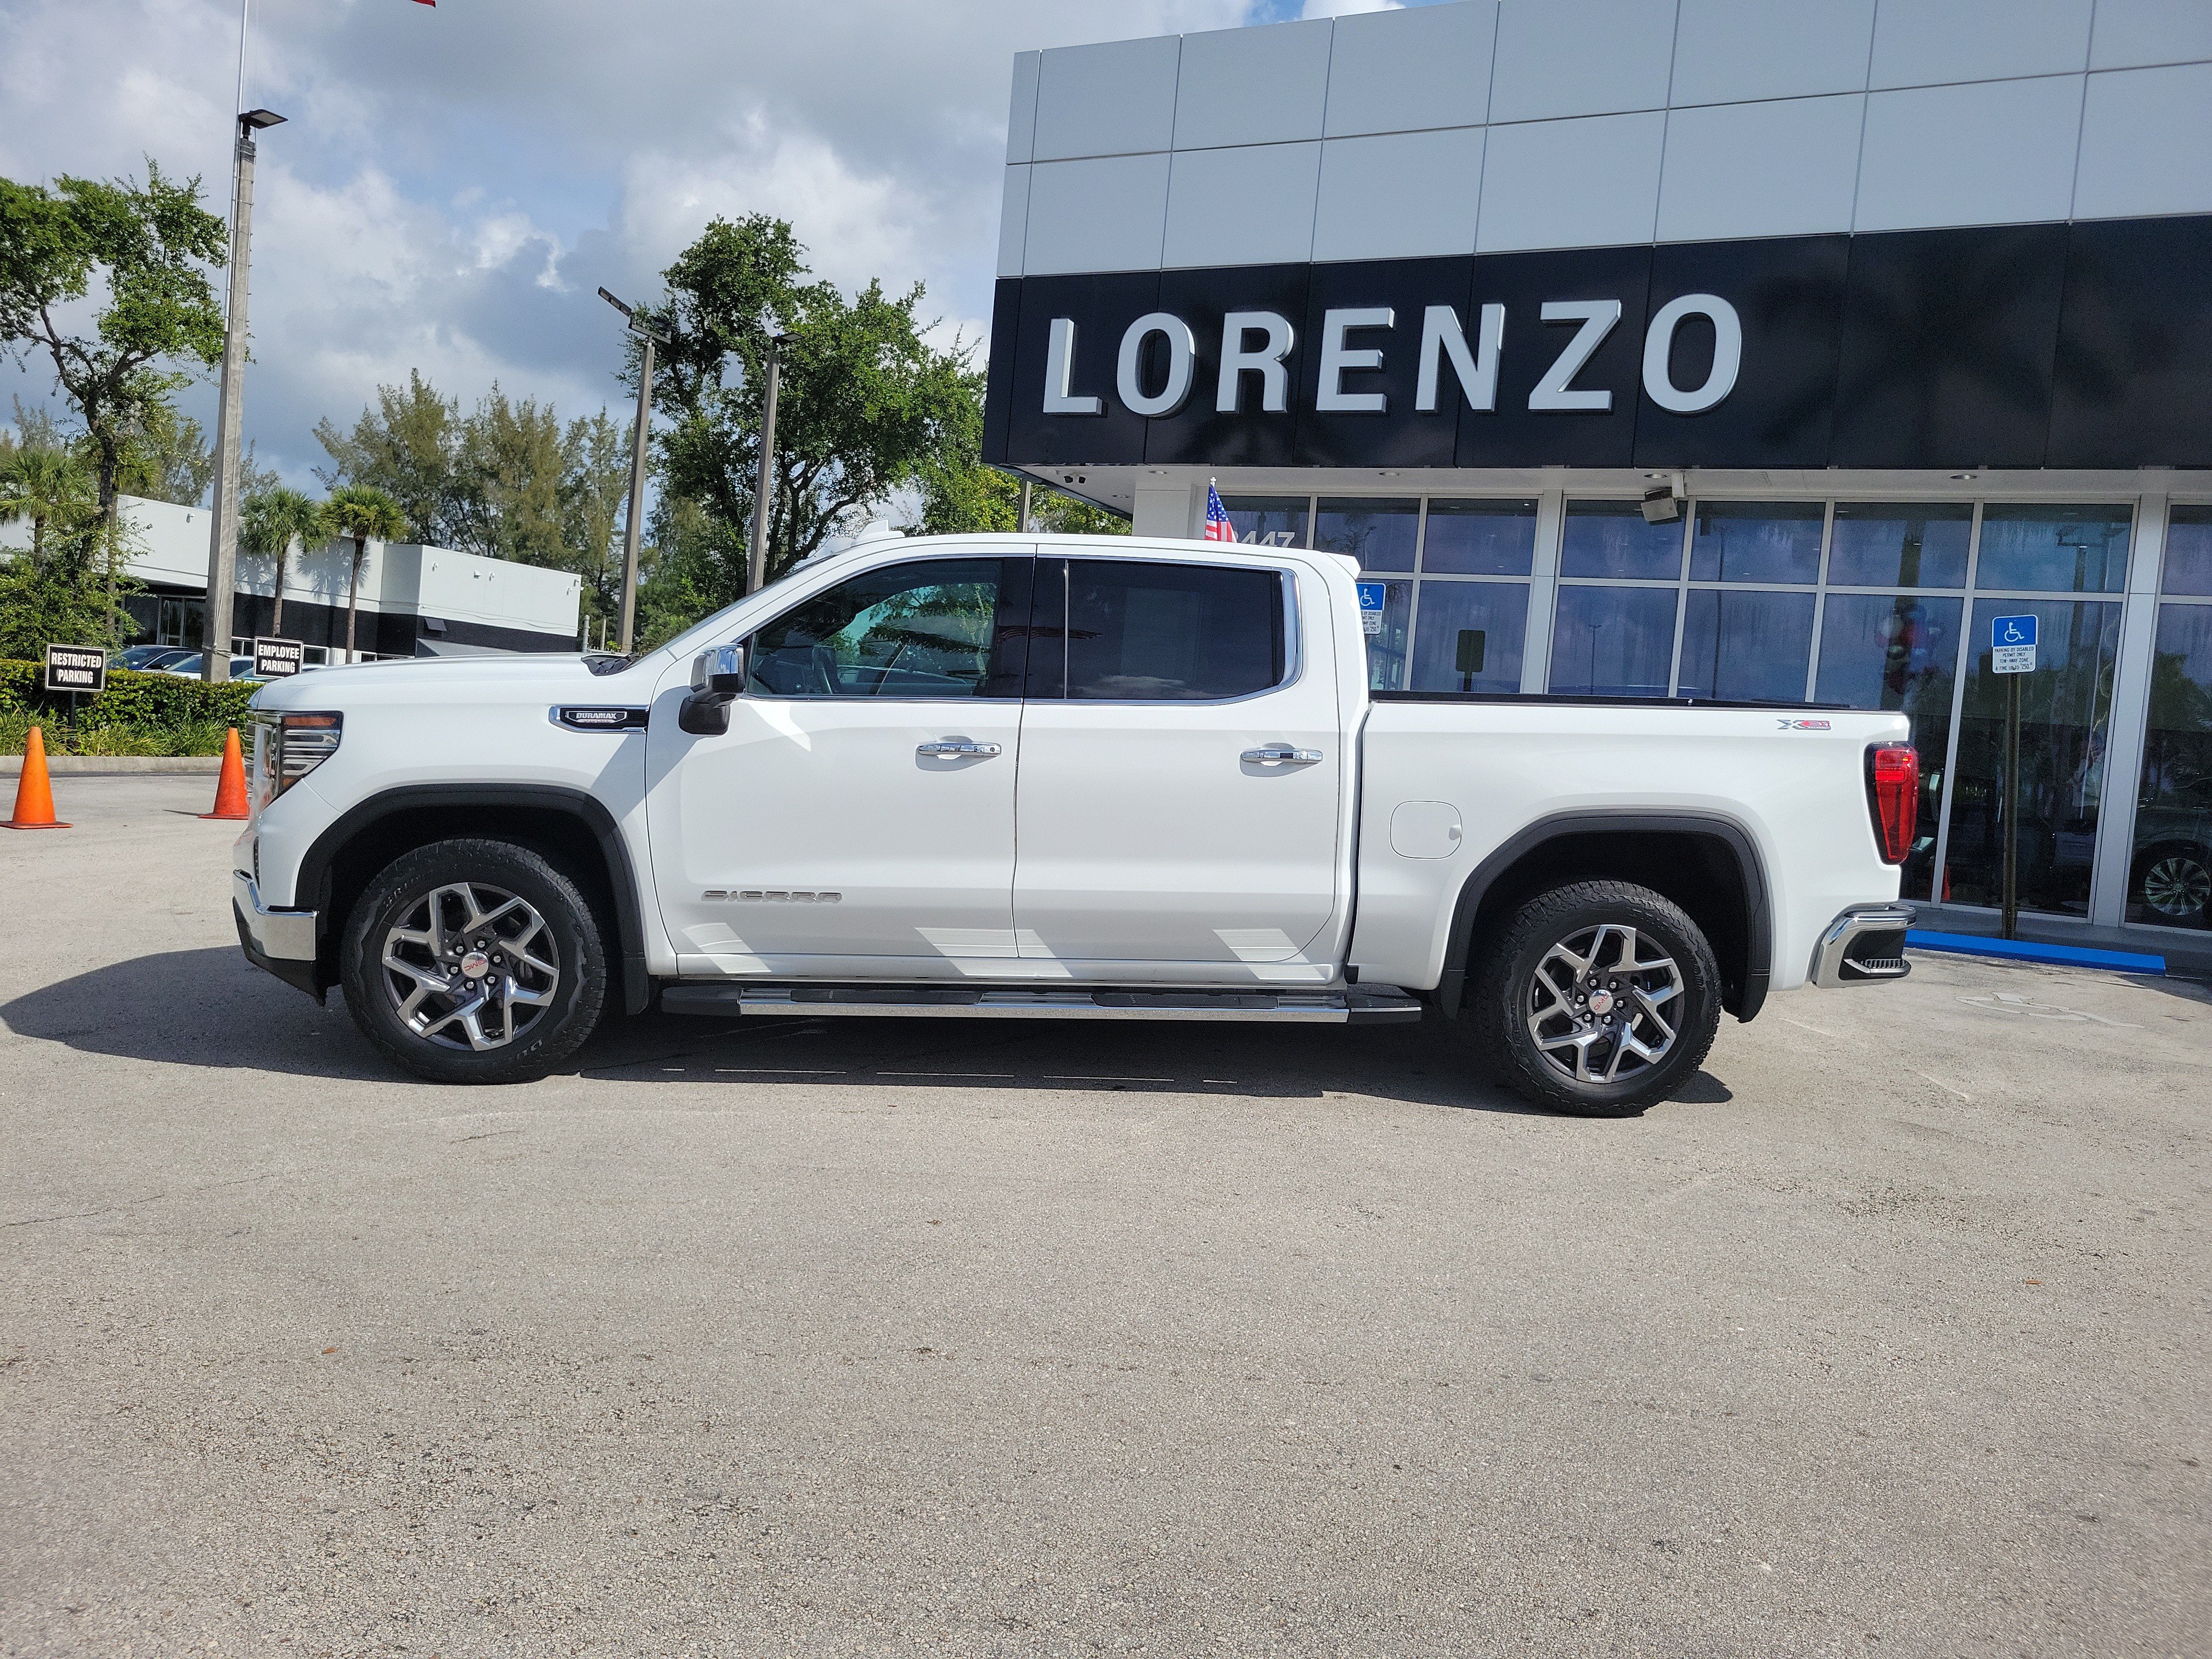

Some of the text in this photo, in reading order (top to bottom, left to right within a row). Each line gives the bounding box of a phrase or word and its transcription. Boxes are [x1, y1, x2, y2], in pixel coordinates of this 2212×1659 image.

[1042, 293, 1742, 417] LORENZO
[258, 644, 300, 659] EMPLOYEE
[51, 652, 102, 668] RESTRICTED
[261, 659, 295, 673] PARKING
[57, 669, 93, 684] PARKING
[701, 890, 843, 904] SIERRA
[464, 958, 486, 972] GMC
[1594, 994, 1610, 1011] GMC
